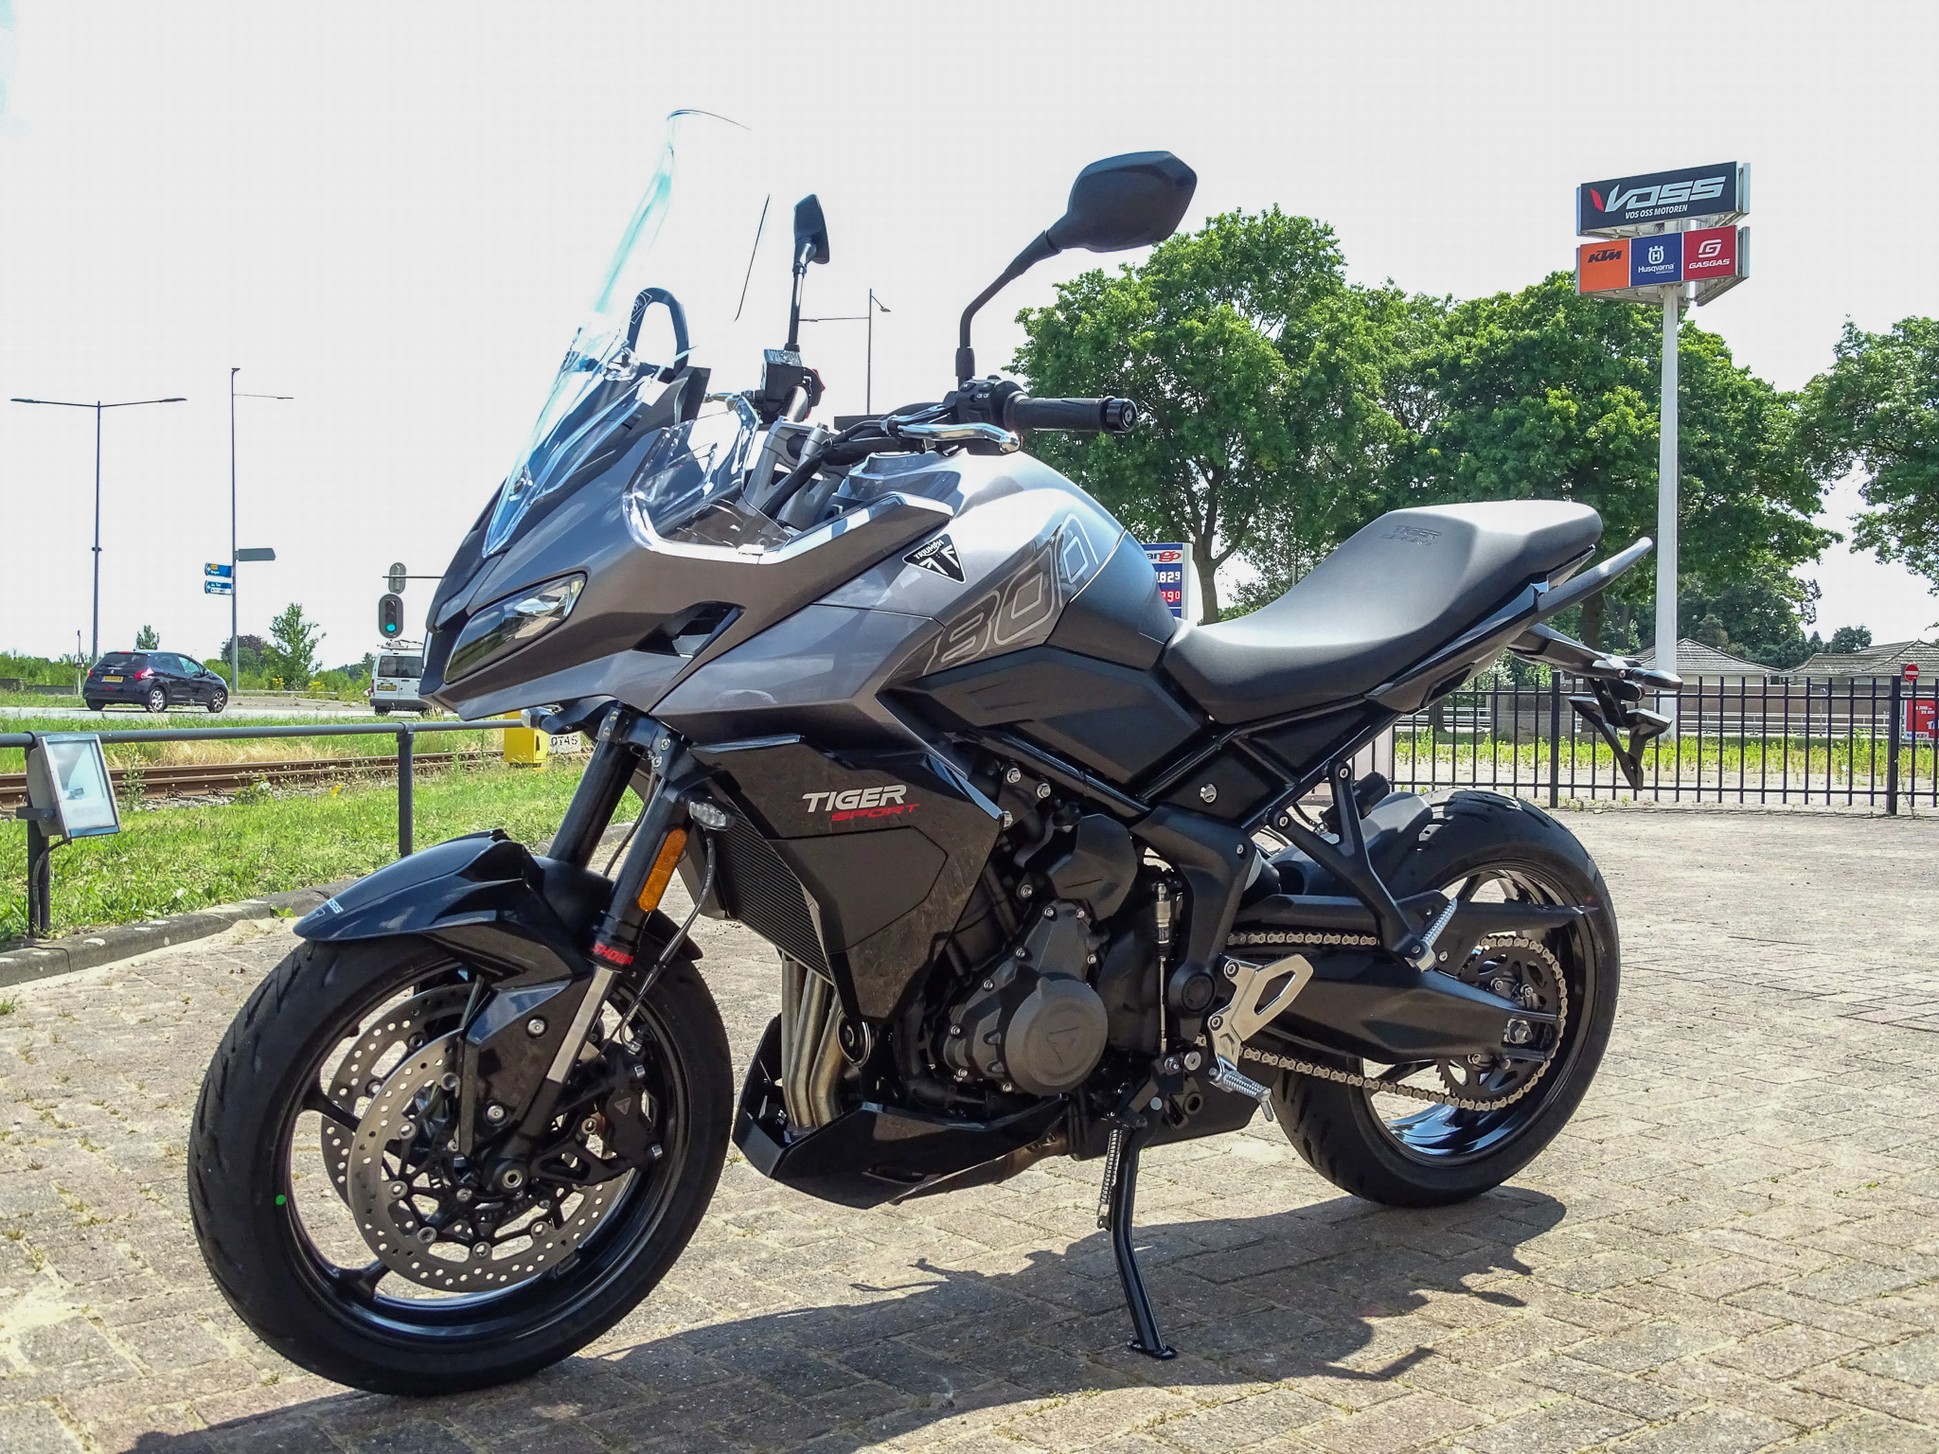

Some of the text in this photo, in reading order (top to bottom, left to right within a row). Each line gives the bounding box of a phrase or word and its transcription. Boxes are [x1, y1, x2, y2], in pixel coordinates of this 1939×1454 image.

[1589, 176, 1727, 212] VOSS
[1625, 204, 1688, 219] VOS OSS MOTOREN
[1587, 248, 1622, 263] KTM
[1689, 258, 1730, 269] GASGAS
[1638, 264, 1675, 274] Husqvarna
[913, 539, 945, 560] TRIUMPH
[802, 784, 907, 813] TIGER
[831, 803, 920, 822] SPORT
